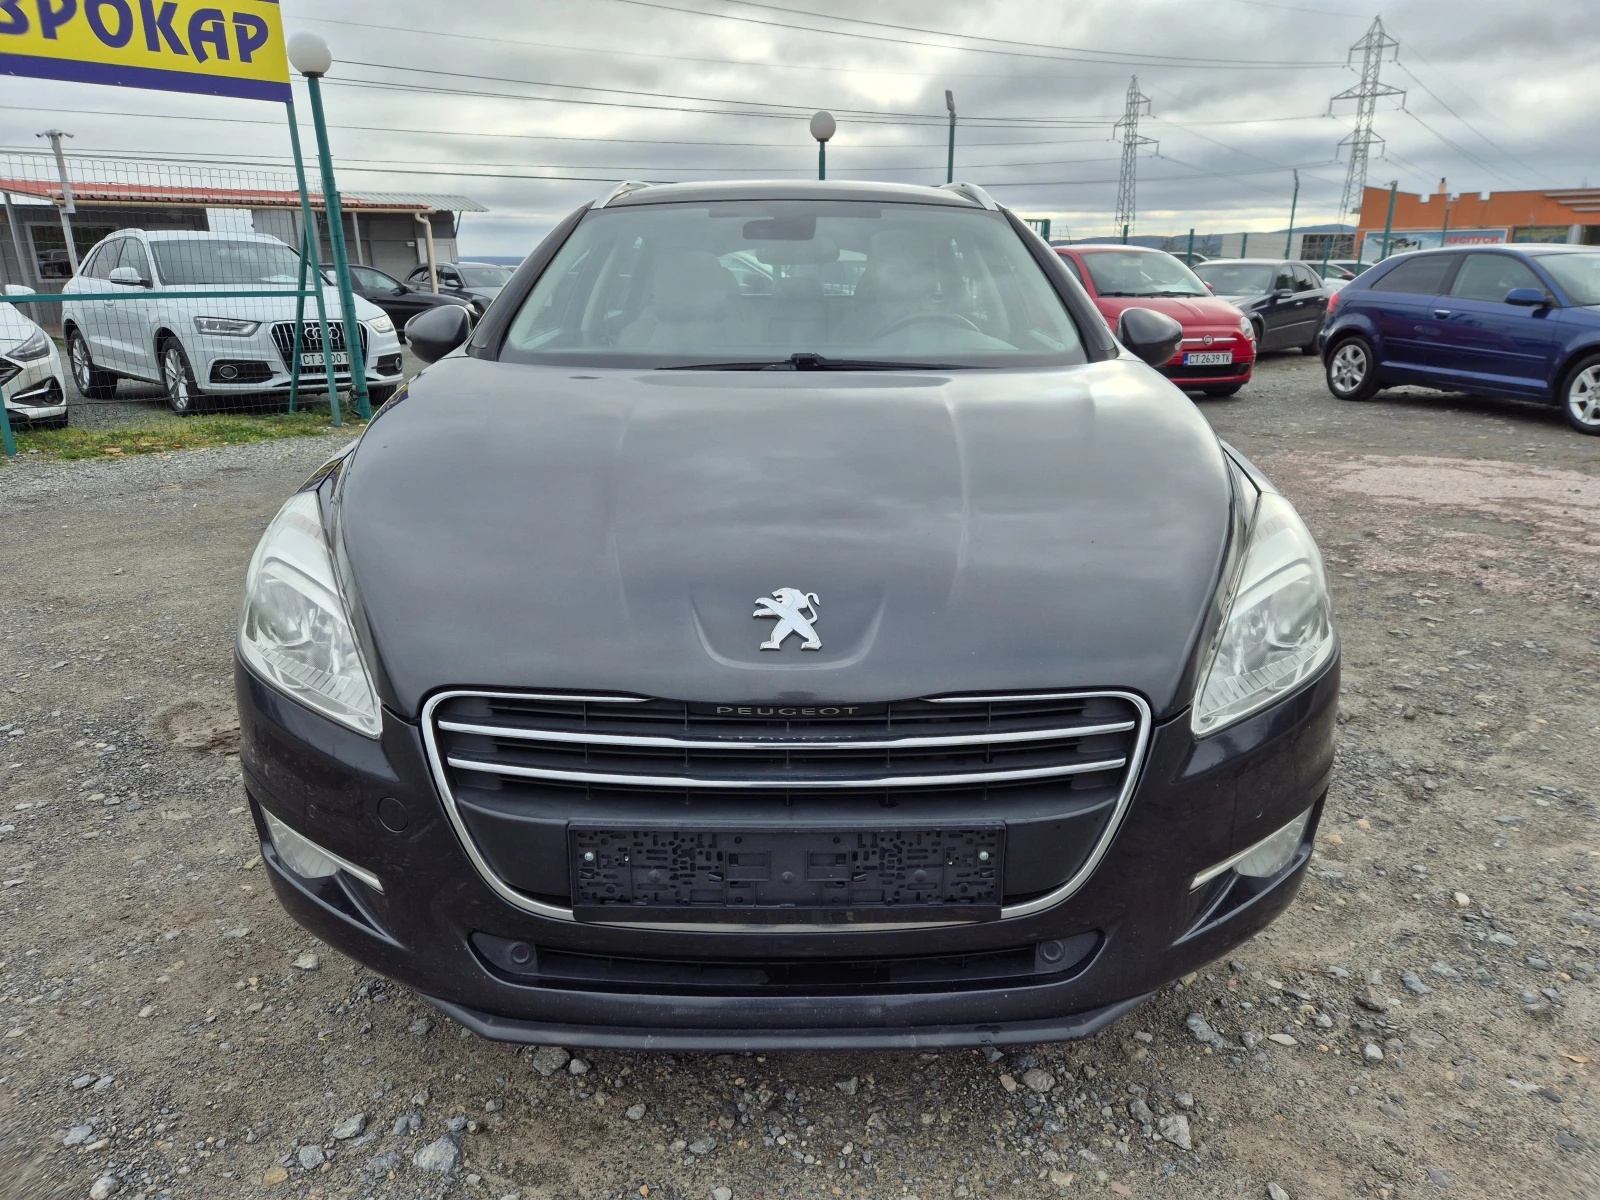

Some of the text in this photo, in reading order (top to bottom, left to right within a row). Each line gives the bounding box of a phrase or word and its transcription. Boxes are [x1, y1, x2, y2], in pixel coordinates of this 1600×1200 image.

[303, 354, 315, 365] CT
[318, 353, 342, 364] 300
[1189, 353, 1230, 364] CT 2639 TK
[716, 706, 859, 716] PEUGEOT
